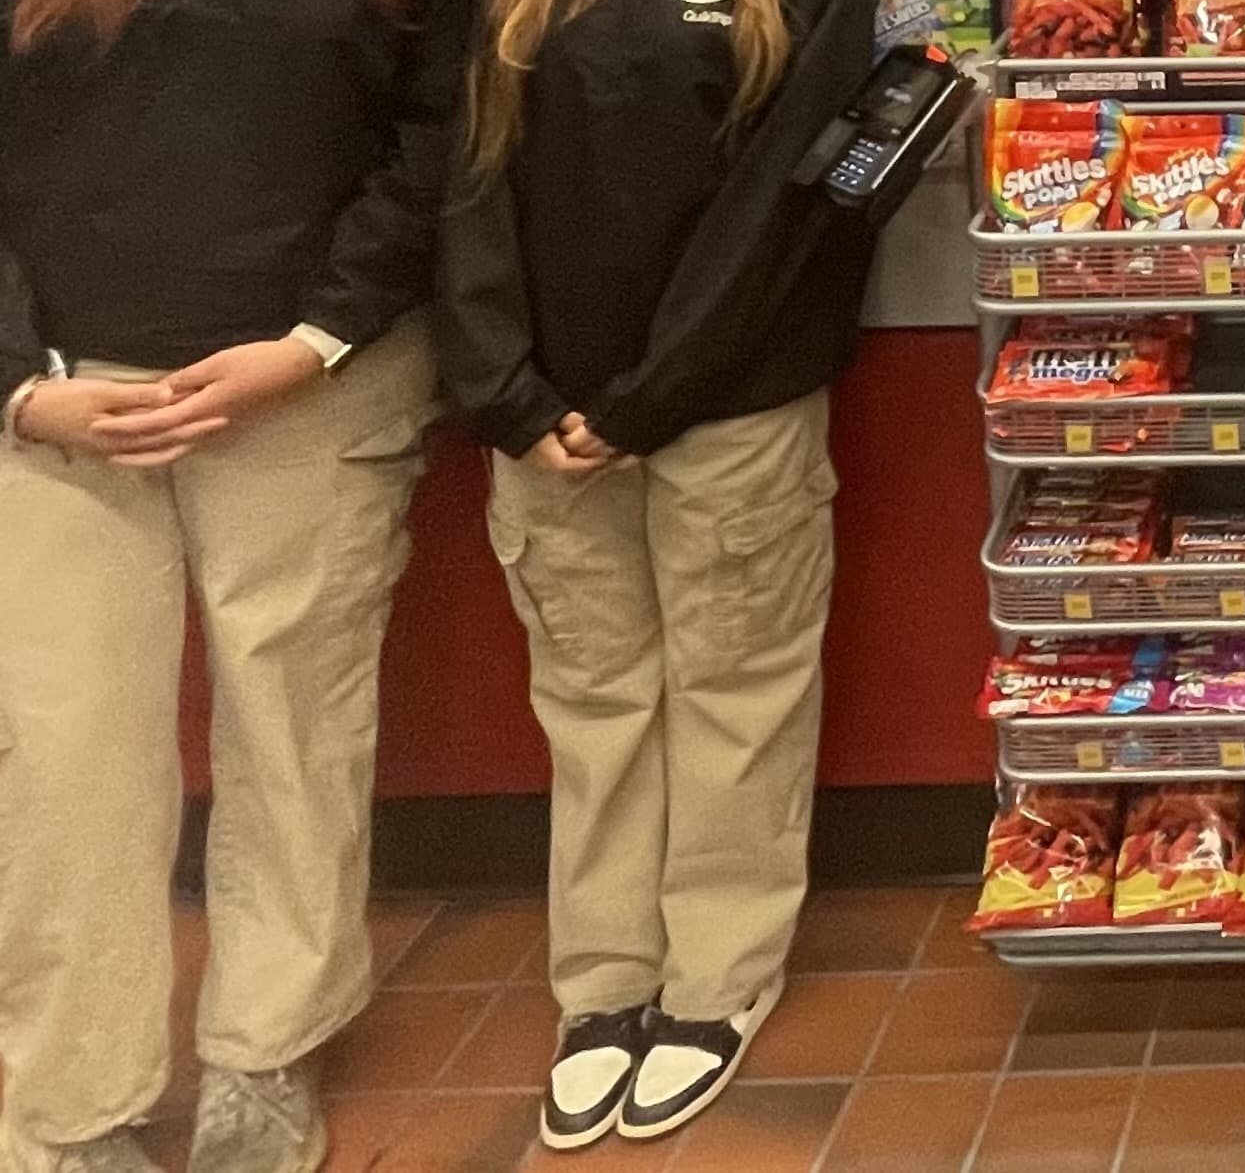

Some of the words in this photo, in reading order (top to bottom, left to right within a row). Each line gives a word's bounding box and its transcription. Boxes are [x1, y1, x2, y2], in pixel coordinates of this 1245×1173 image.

[1002, 157, 1106, 200] Skittles
[1132, 156, 1230, 199] Skittles
[1030, 367, 1108, 382] mega
